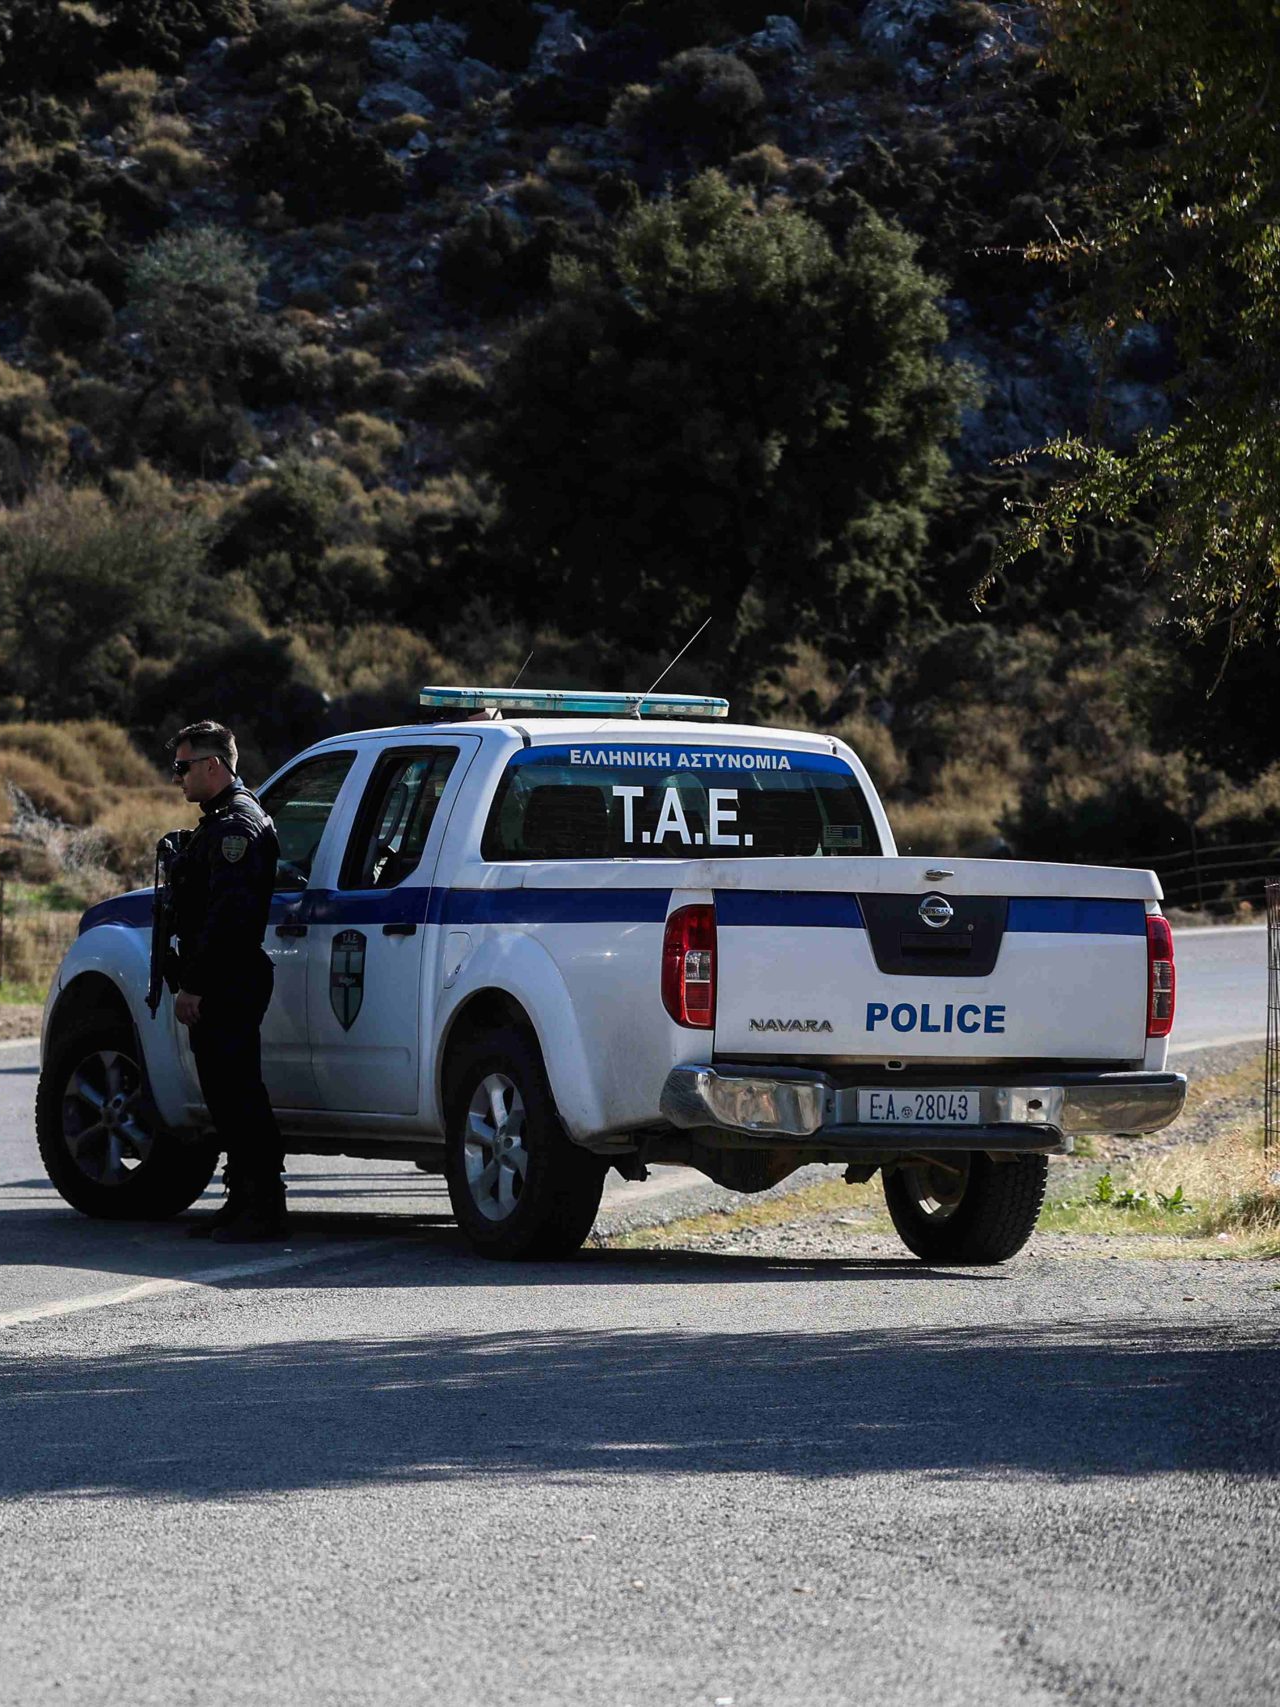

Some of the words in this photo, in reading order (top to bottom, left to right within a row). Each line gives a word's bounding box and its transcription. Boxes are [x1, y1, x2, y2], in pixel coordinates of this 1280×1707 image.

[570, 749, 671, 767] ΕΛΛΗΝΙΚΗ
[677, 753, 791, 770] ΑΣΤΥΝΟΜΙΑ
[748, 1018, 834, 1033] NAVARA
[865, 1002, 1006, 1034] POLICE
[915, 1094, 968, 1121] 28043
